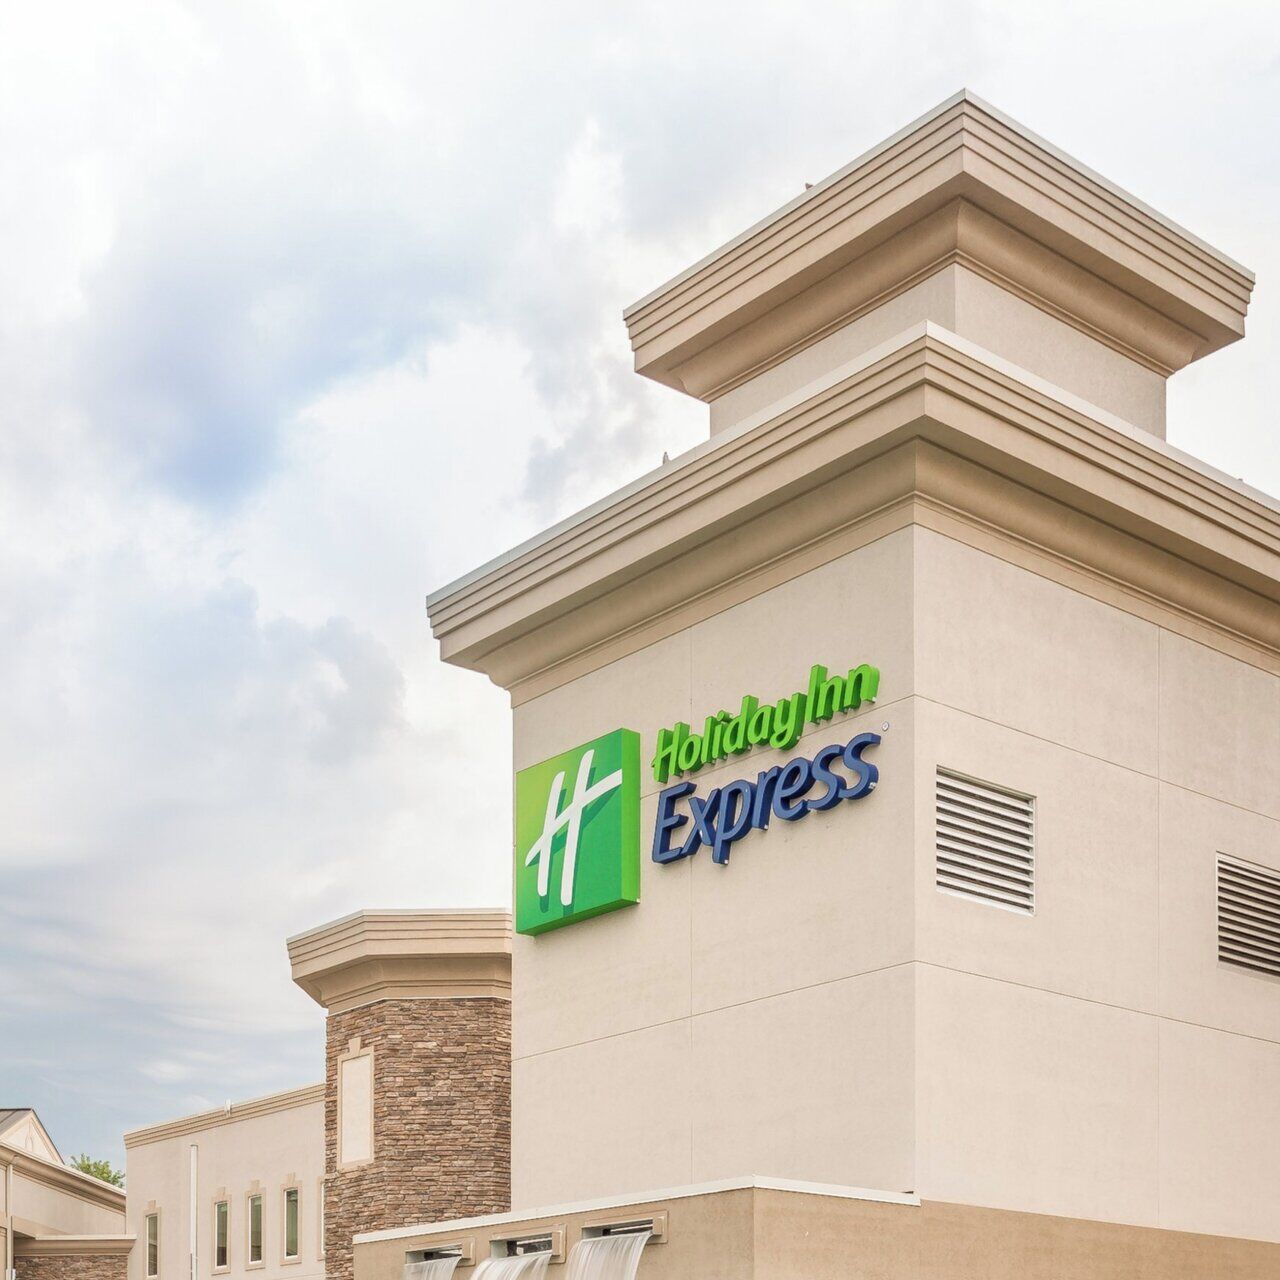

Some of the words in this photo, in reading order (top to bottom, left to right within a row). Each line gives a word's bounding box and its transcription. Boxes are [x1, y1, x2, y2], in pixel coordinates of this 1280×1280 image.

[651, 692, 807, 784] Holiday
[805, 664, 881, 724] Inn
[652, 732, 882, 865] Express
